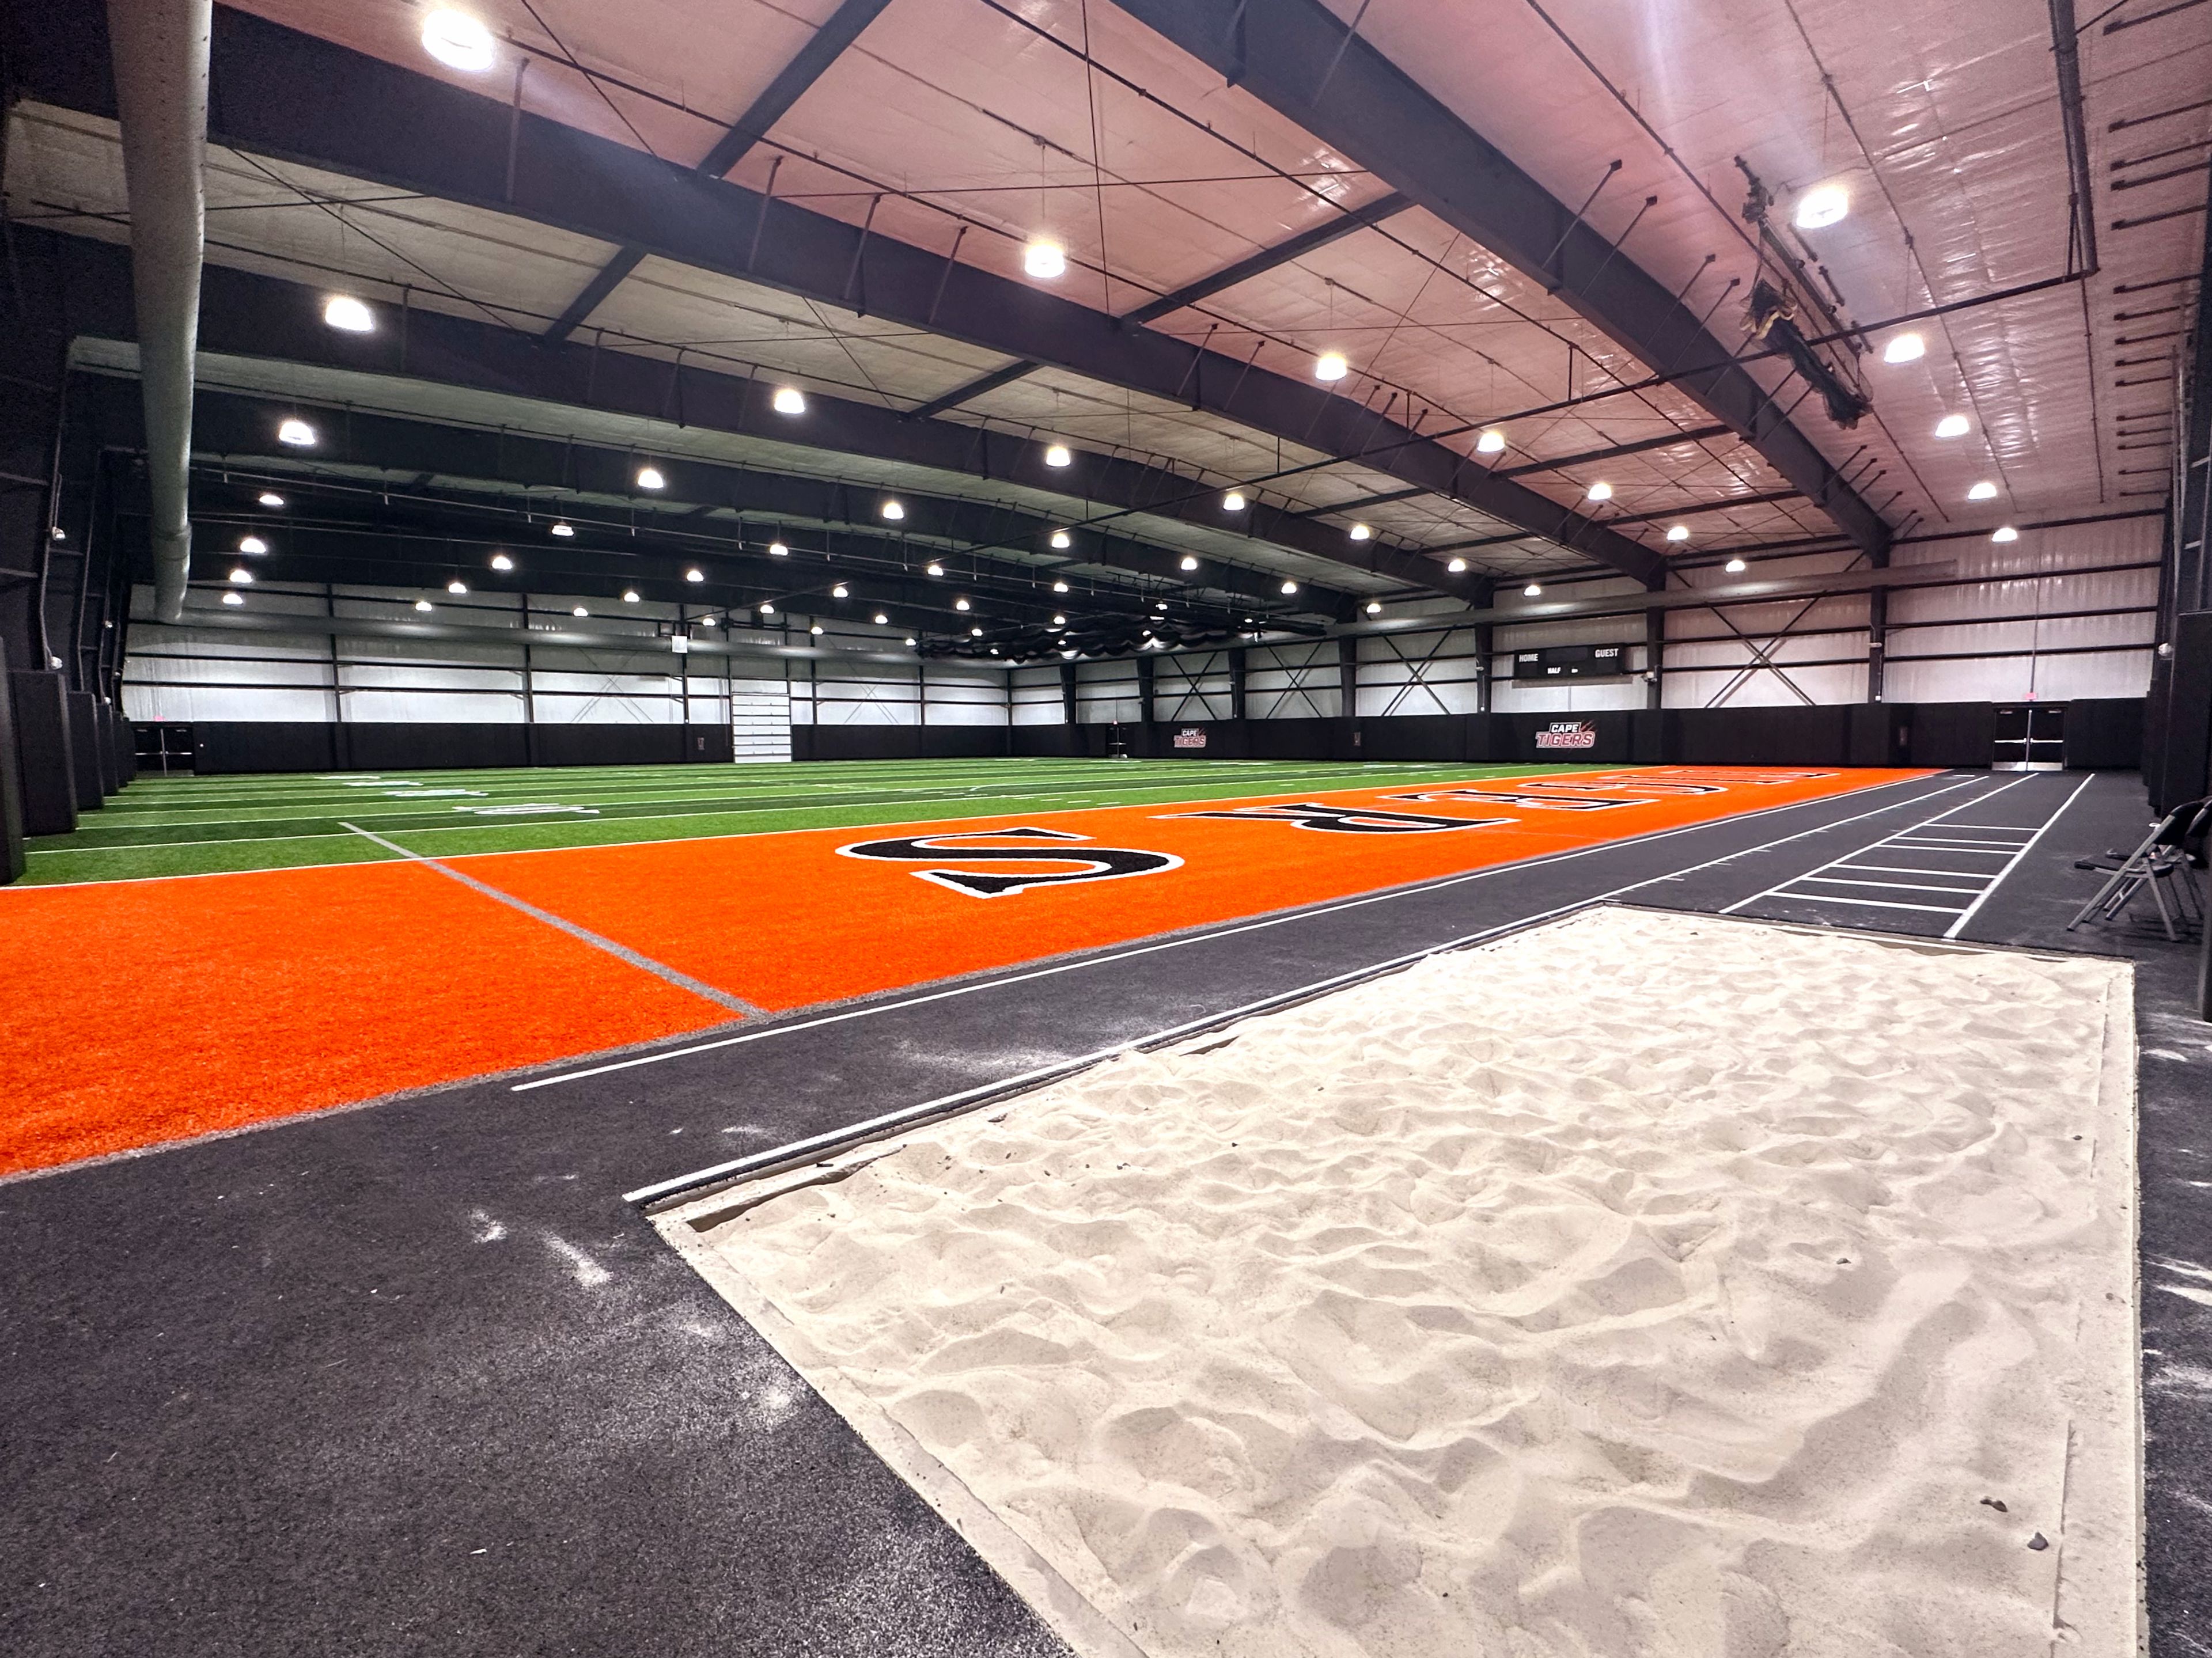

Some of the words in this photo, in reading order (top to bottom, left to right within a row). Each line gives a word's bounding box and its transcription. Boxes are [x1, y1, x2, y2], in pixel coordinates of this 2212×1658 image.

[1519, 654, 1538, 662] HOME
[1595, 648, 1619, 658] GUEST
[1551, 724, 1580, 733] CAPE
[1174, 736, 1206, 748] TIGERS
[1536, 732, 1594, 748] TIGERS
